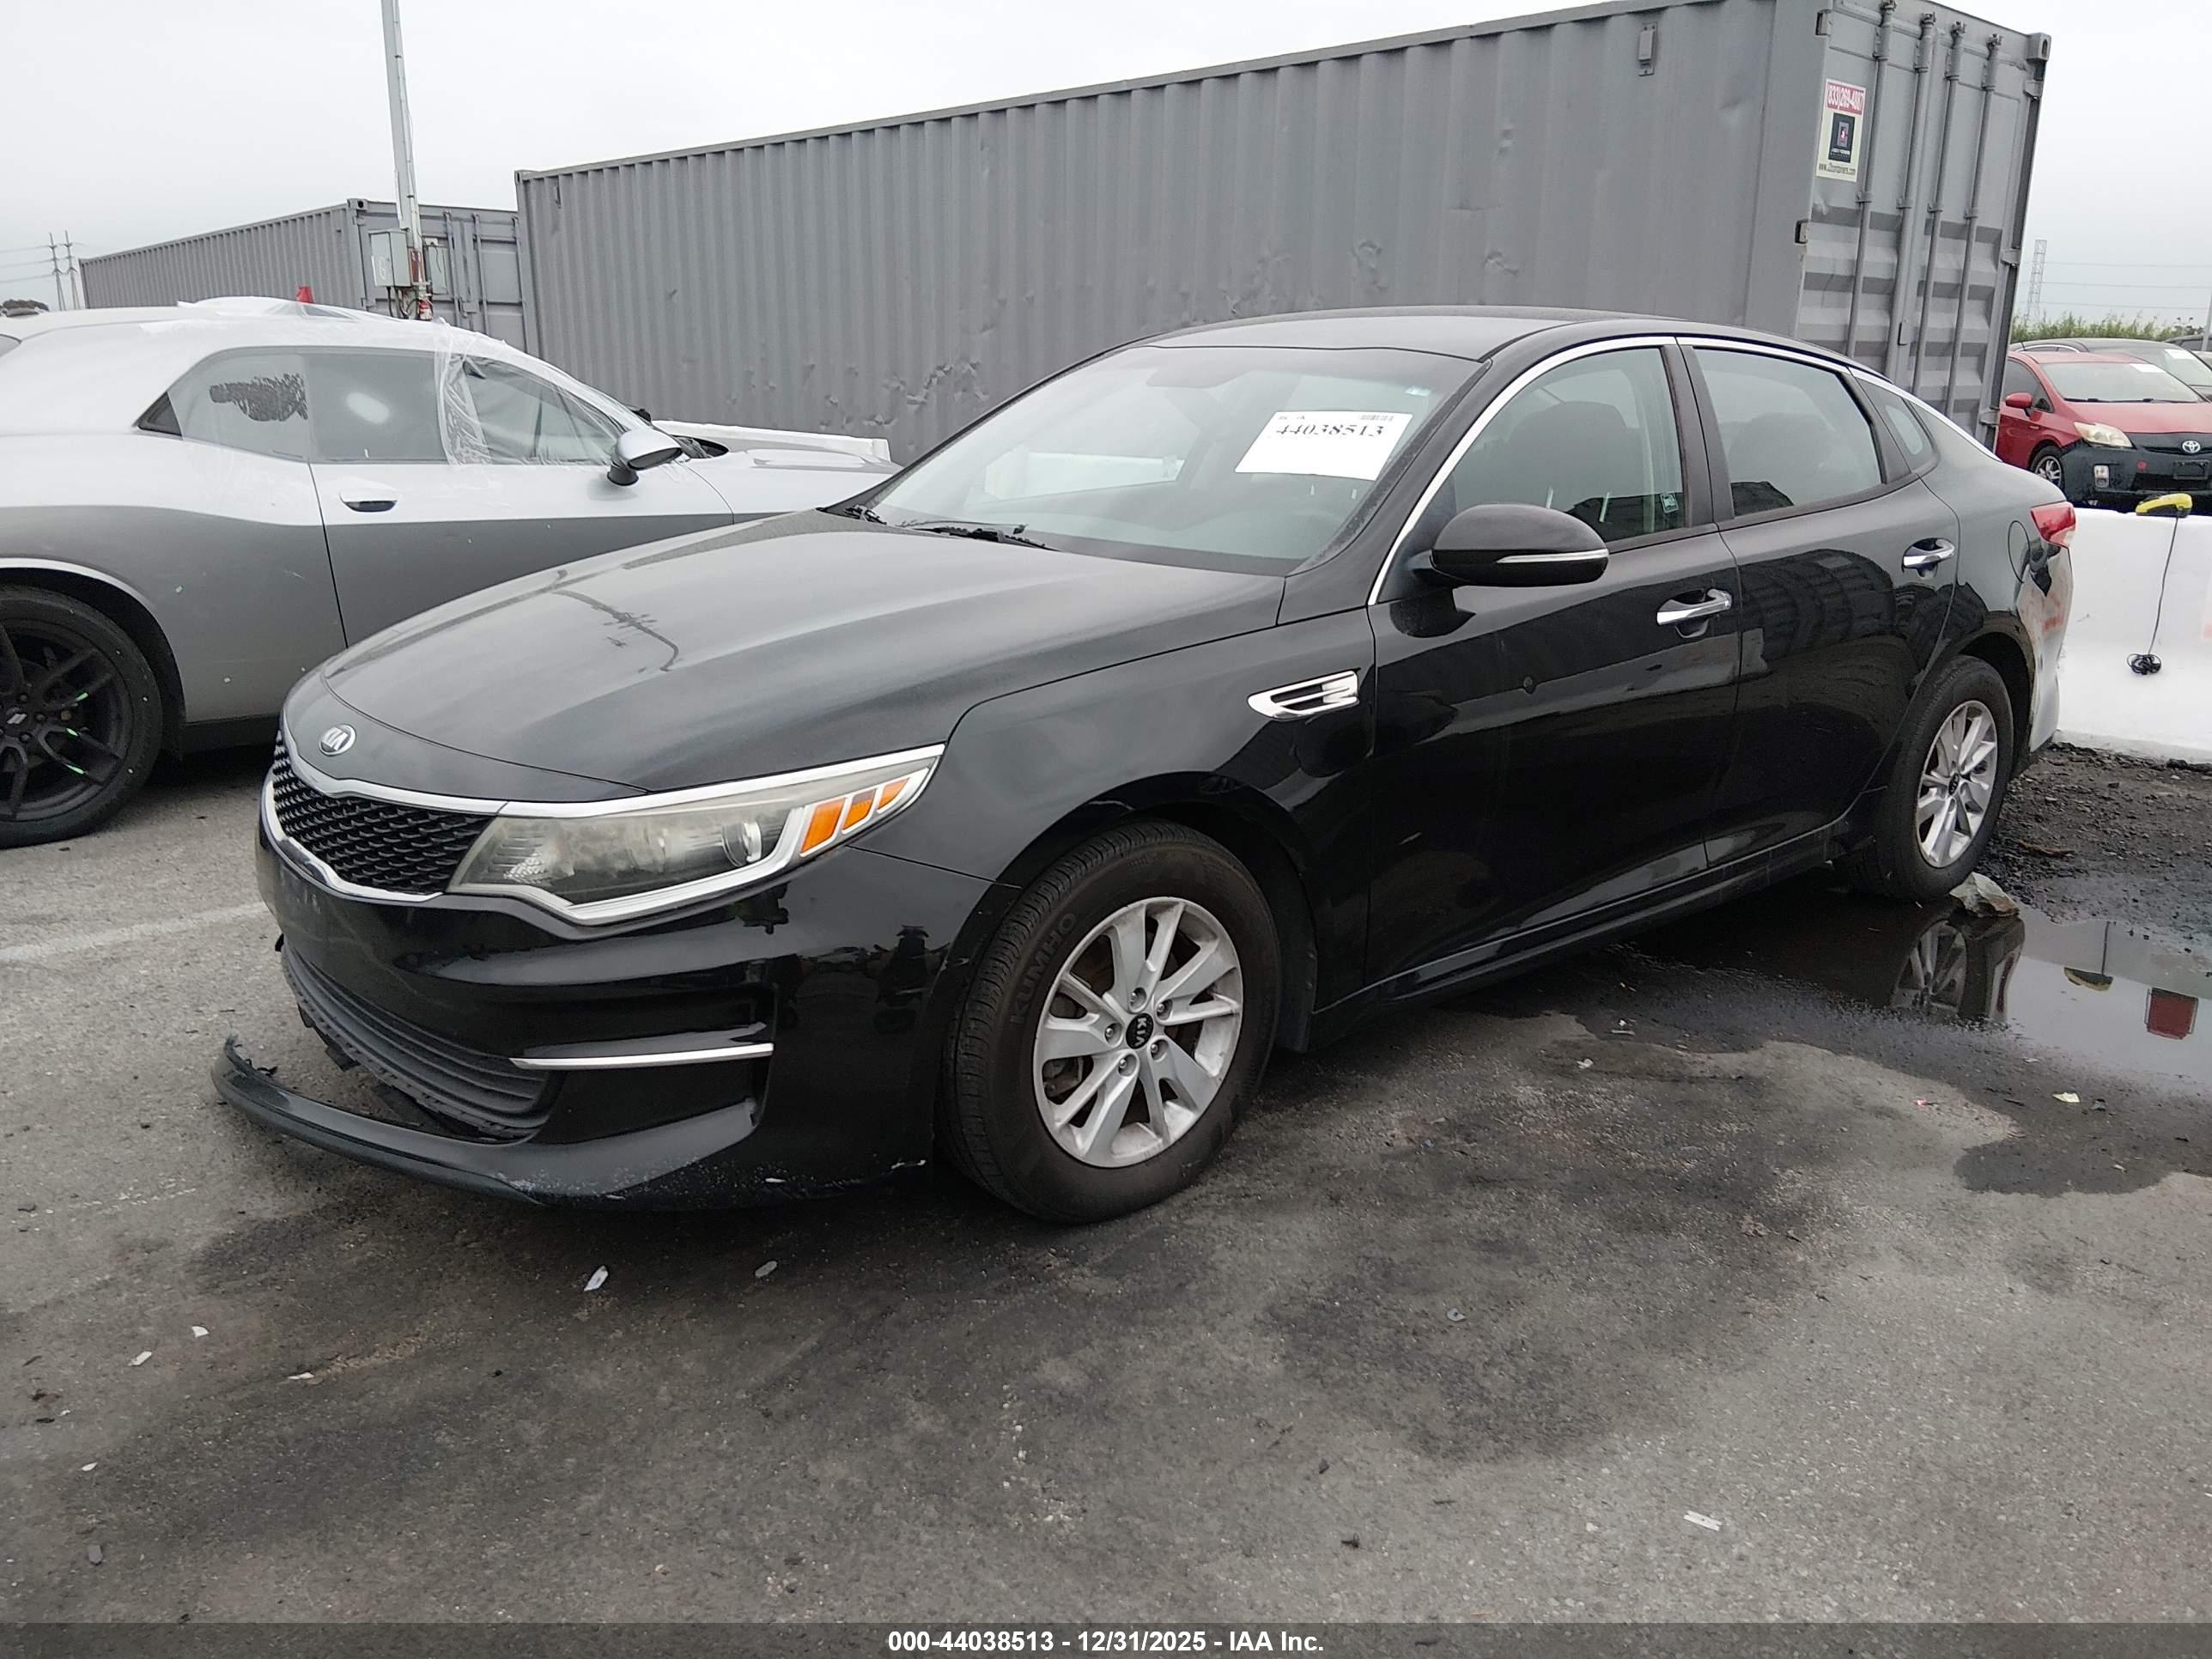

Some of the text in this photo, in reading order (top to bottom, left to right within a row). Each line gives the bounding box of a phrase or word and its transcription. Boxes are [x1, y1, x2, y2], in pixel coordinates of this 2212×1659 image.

[1275, 424, 1385, 437] 44038513
[1010, 913, 1077, 1024] KUMHO
[1135, 1018, 1146, 1047] KIA
